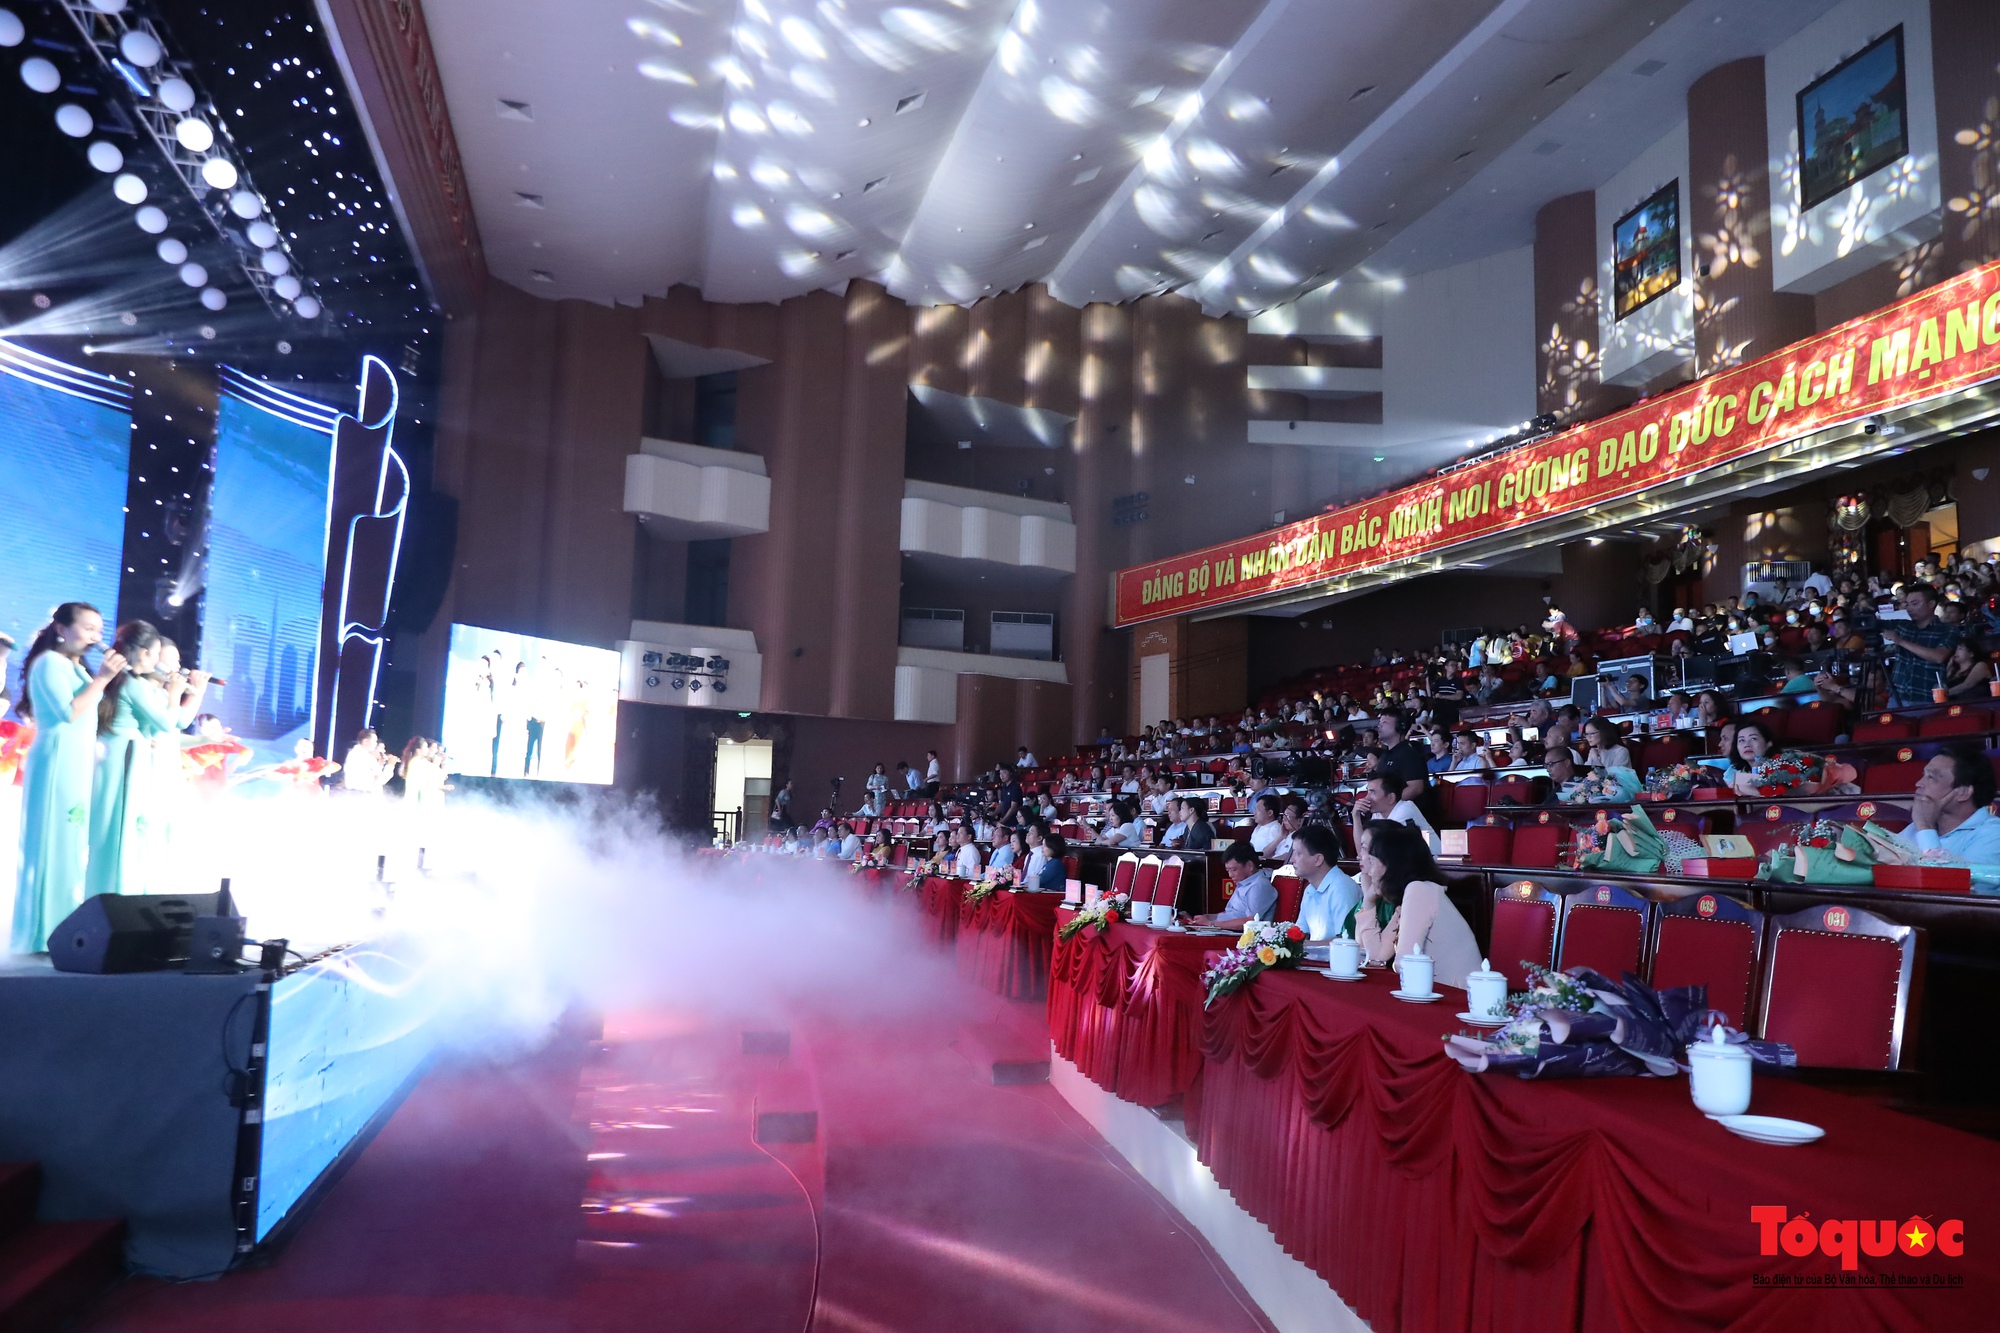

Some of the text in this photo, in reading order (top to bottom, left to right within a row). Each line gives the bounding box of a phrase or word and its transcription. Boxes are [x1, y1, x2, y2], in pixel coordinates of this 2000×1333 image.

[1142, 563, 1184, 605] ĐẢNG
[1188, 560, 1209, 596] BỘ
[1215, 557, 1236, 588] VÀ
[1240, 541, 1291, 581] NHÂN
[1340, 509, 1382, 555] BẮC
[1388, 496, 1443, 543] NINH
[1449, 481, 1491, 523] NOI
[1498, 447, 1590, 508] GƯƠNG
[1597, 422, 1660, 479] ĐẠO
[1668, 393, 1738, 454] ĐỨC
[1747, 347, 1856, 425] CÁCH
[1225, 881, 1234, 896] C
[1700, 899, 1714, 912] 032
[1827, 911, 1845, 927] 031
